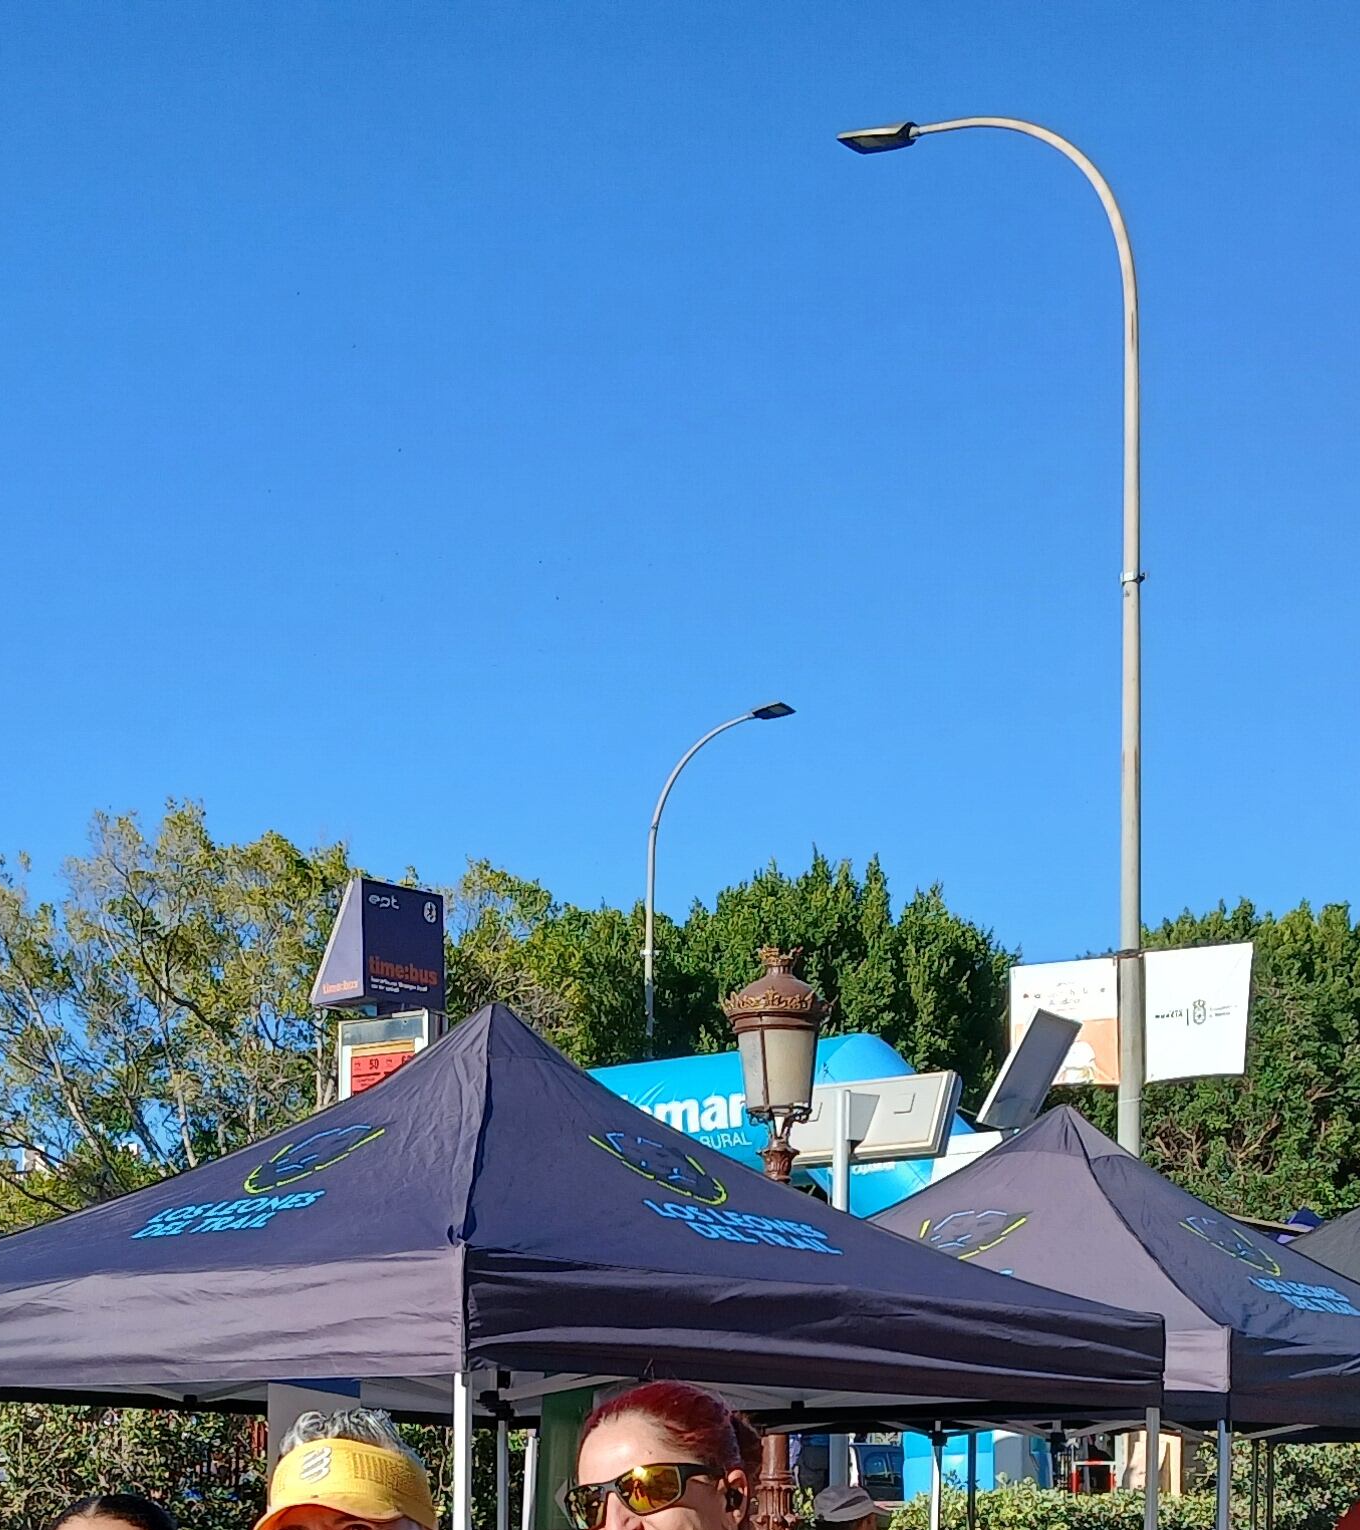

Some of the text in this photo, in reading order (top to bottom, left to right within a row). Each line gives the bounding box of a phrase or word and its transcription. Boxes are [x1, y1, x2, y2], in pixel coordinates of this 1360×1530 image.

[147, 1190, 325, 1224] LOS LEONES
[190, 1211, 277, 1233] TRAIL
[643, 1200, 830, 1241] LOS LEONES
